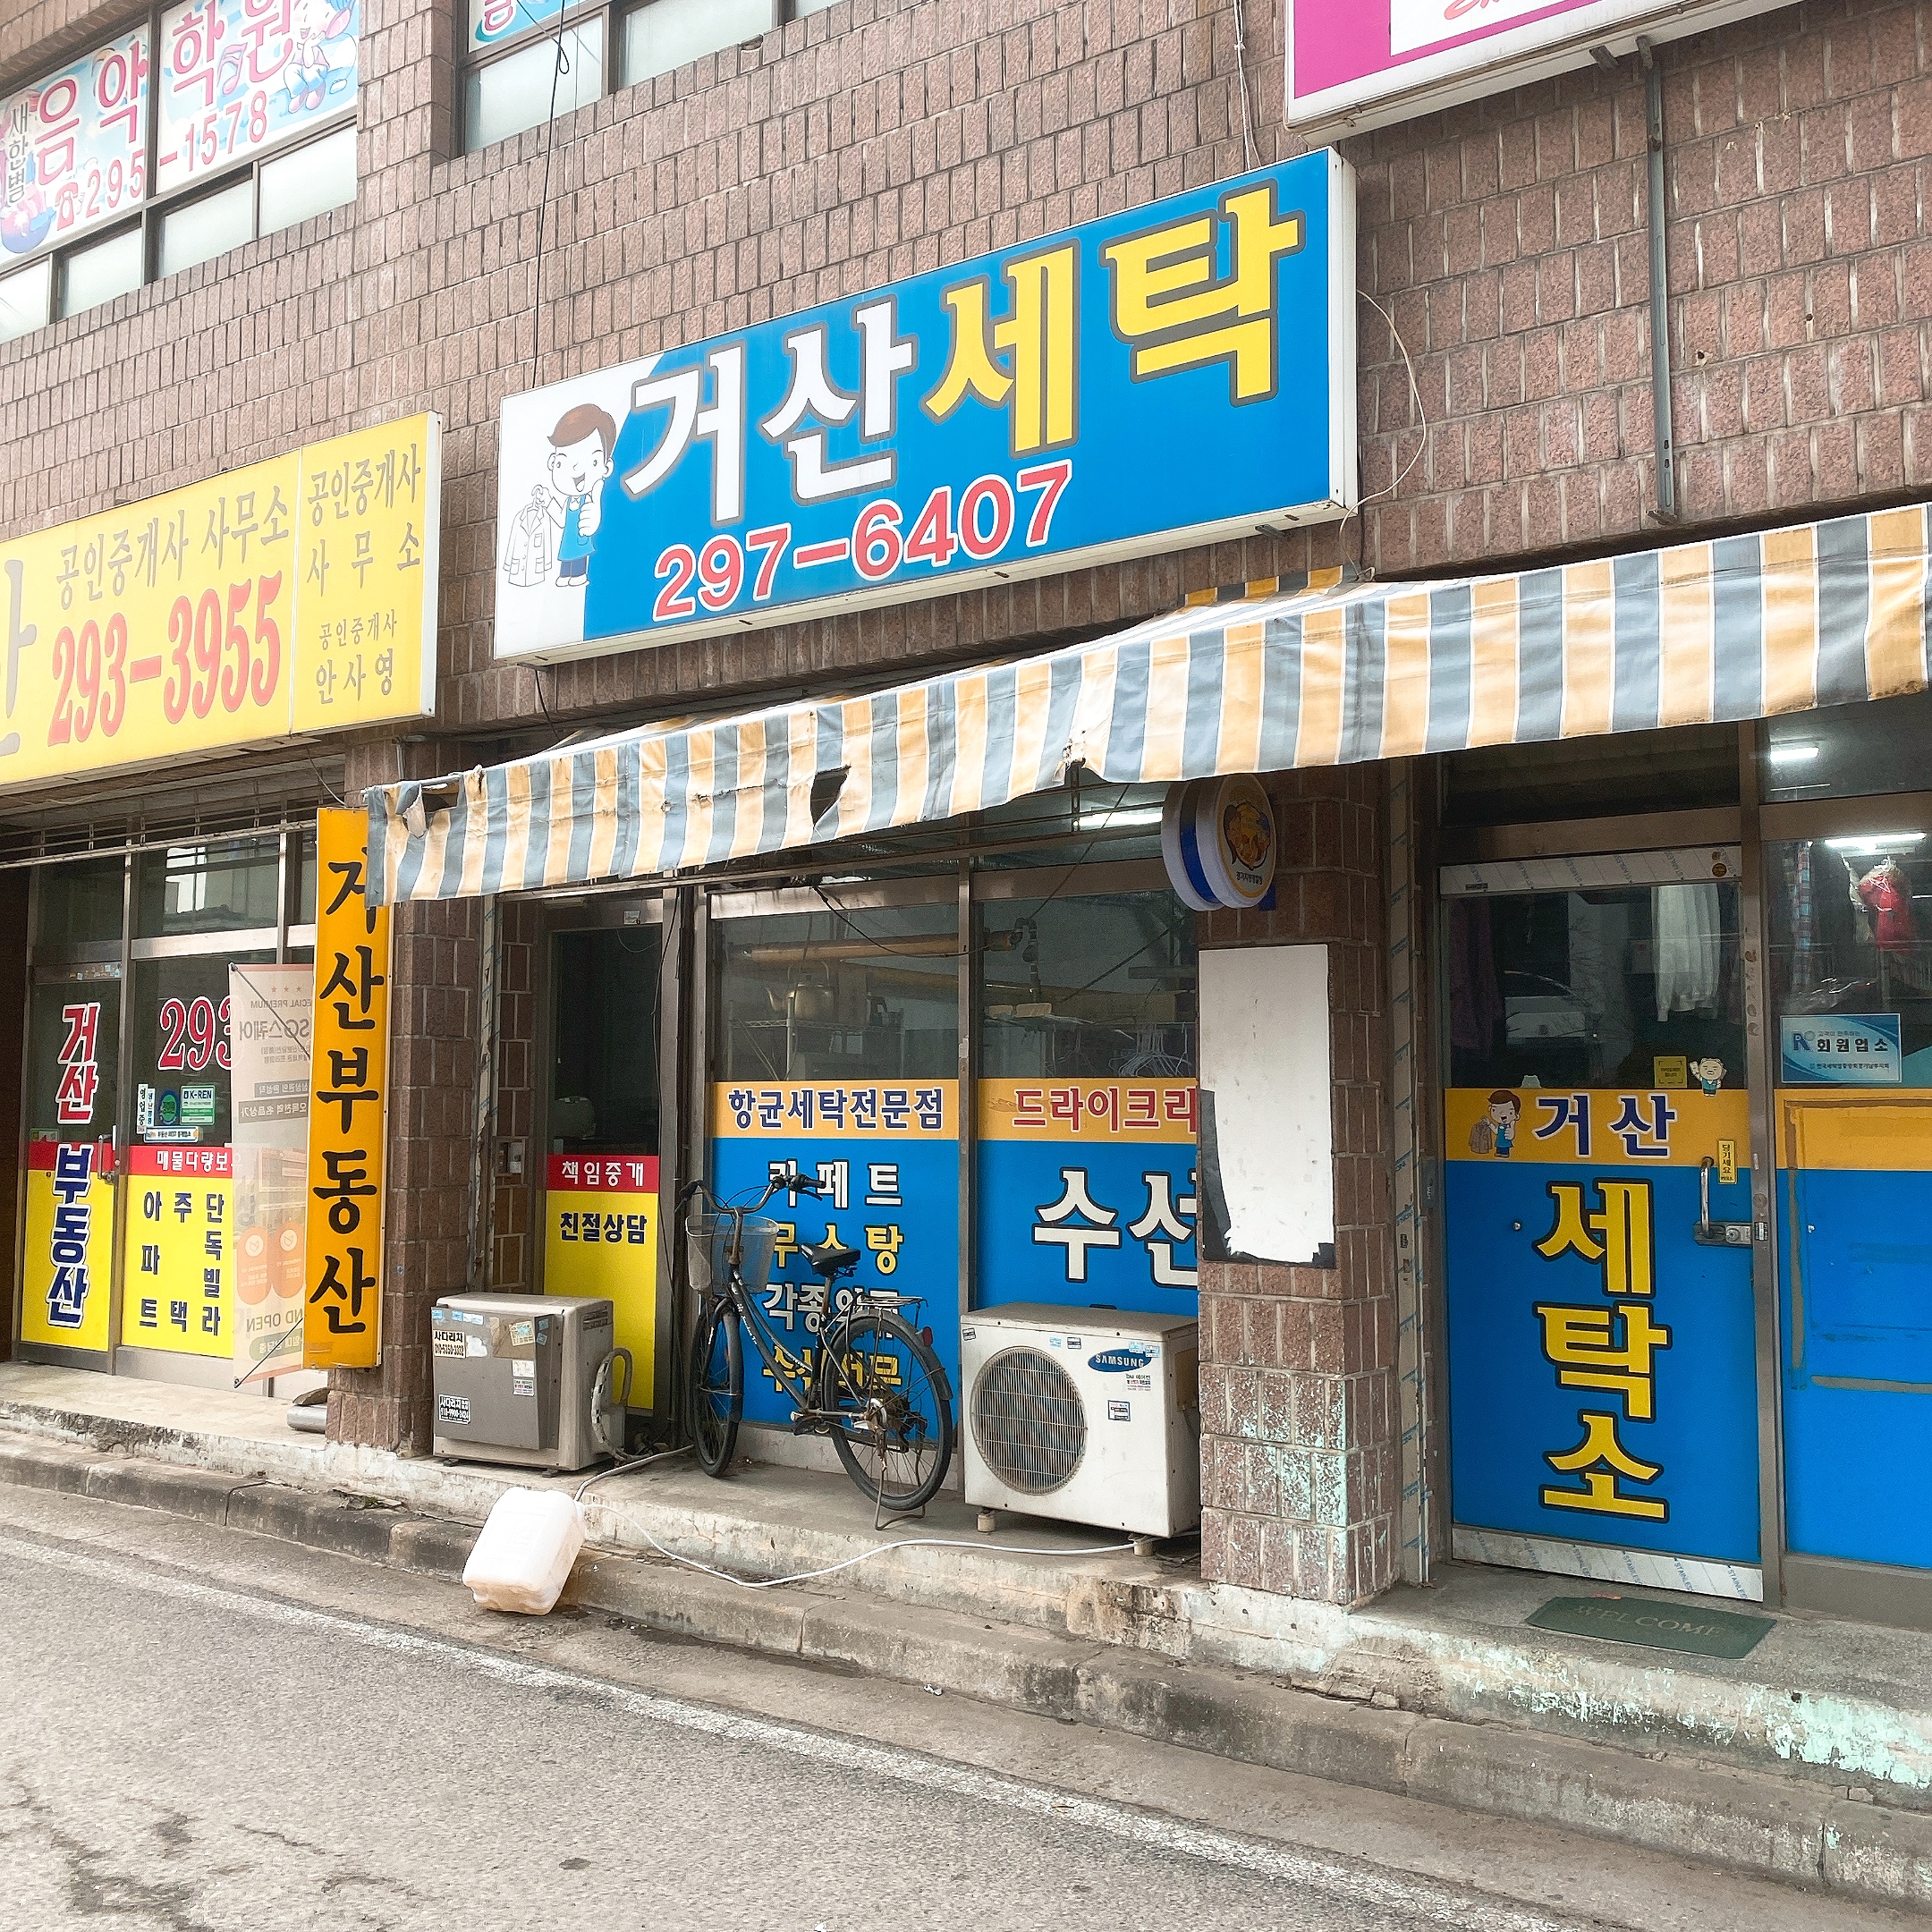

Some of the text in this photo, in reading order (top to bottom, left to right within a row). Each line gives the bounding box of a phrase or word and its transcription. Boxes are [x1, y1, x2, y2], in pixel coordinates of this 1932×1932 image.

[86, 90, 267, 220] 295-1578
[308, 443, 421, 526] 공인중개사
[56, 485, 289, 610] 공인중개사 사무소
[652, 458, 1072, 623] 297-6407
[47, 570, 283, 747] 293-3955
[318, 608, 397, 651] 공인중개사
[316, 648, 394, 704] 안사영
[1817, 1038, 1889, 1053] 회원업소
[727, 1088, 945, 1131] 항균세탁전문점
[1533, 1091, 1677, 1161] 거산
[47, 1002, 100, 1329] 거산 부동산
[561, 1159, 645, 1187] 책임중개
[559, 1211, 648, 1244] 친절상담
[434, 1330, 463, 1343] 사다리차
[1094, 1352, 1144, 1368] SAMSUNG
[1533, 1174, 1673, 1523] 세탁소
